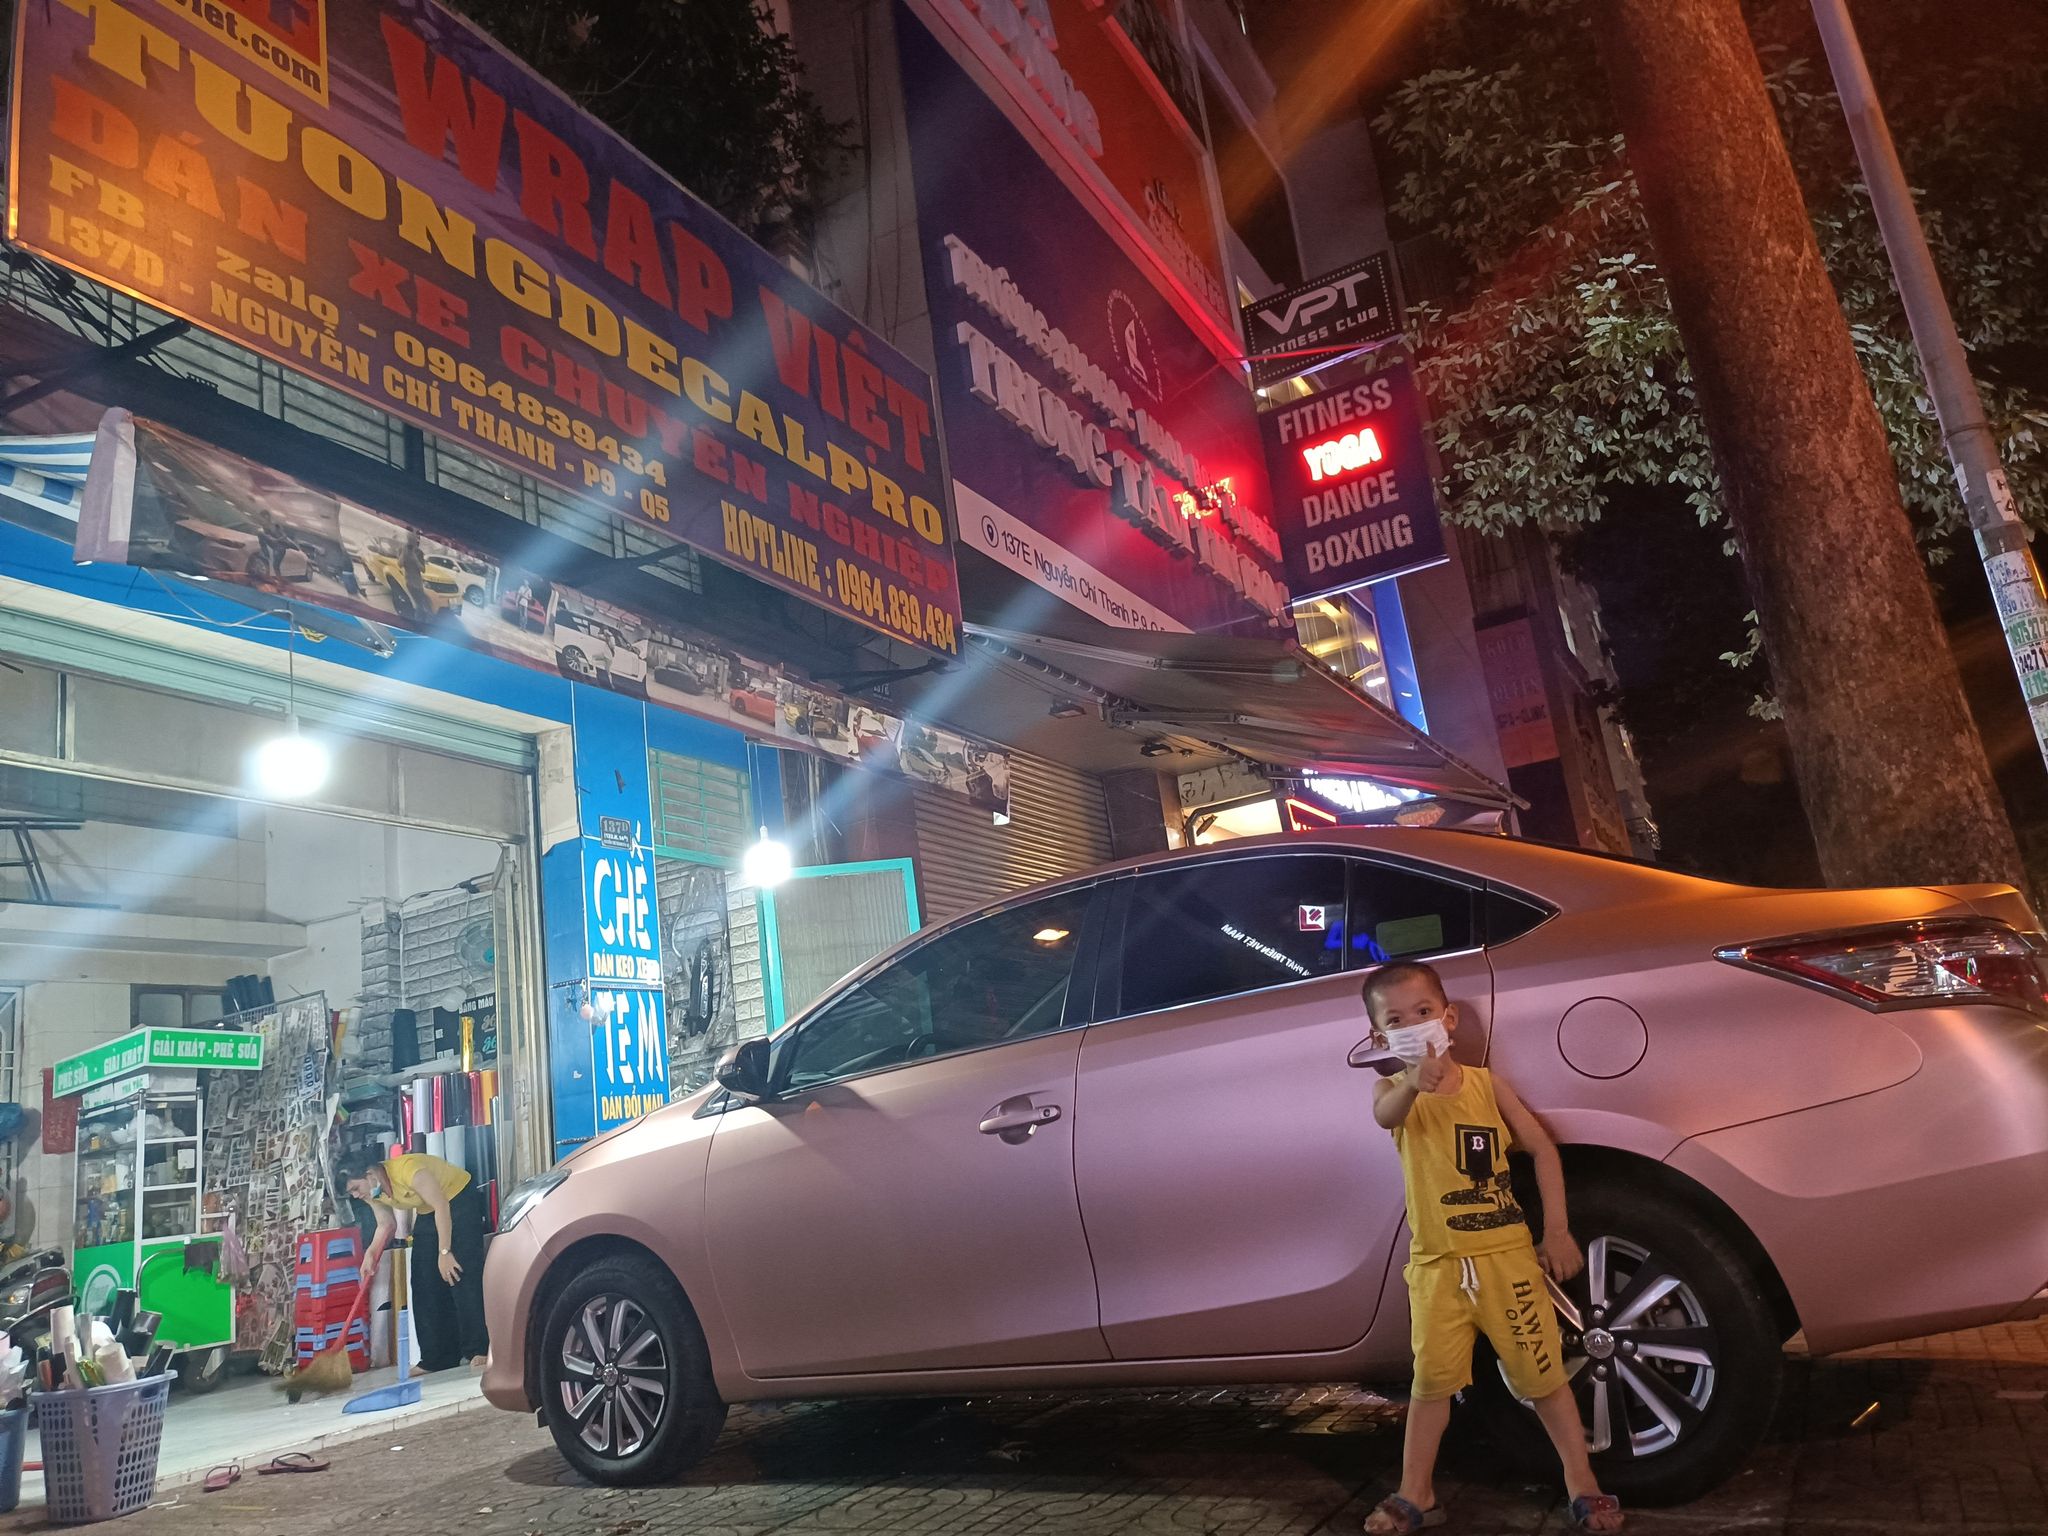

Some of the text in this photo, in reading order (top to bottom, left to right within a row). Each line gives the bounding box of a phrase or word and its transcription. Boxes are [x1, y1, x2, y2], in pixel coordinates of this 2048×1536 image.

[175, 0, 322, 95] iet.com
[57, 0, 944, 545] TUONGDECALPRO
[380, 12, 734, 335] WRAP
[759, 285, 932, 474] VIỆT
[51, 74, 950, 593] DÁN XE CHUYÊN NGHIỆP
[1256, 271, 1371, 335] VPT
[1260, 305, 1379, 364] FITNESS CLUB
[49, 203, 165, 288] 137D
[210, 280, 370, 385] NGUYỄN
[383, 365, 442, 418] CHÍ
[451, 396, 557, 471] THANH
[582, 458, 617, 498] P9
[640, 487, 670, 523] Q5
[394, 330, 667, 488] 0964839434
[956, 320, 1112, 487] TRUNG
[1277, 377, 1392, 445] FITNESS
[1302, 427, 1383, 481] YOGA
[1301, 469, 1399, 529] DANCE
[1304, 513, 1414, 575] BOXING
[720, 500, 821, 593] HOTLINE
[836, 557, 957, 655] 0964.839.434
[1001, 530, 1033, 566] 137E
[1034, 548, 1078, 592] Nguyễn
[1098, 588, 1130, 625] Thanh
[593, 949, 614, 977] DÁN
[615, 955, 635, 978] KEO
[177, 1038, 206, 1057] KHÁT
[596, 989, 665, 1084] TEM
[601, 1090, 622, 1121] DÁN
[624, 1085, 642, 1119] ĐỔI
[1512, 1279, 1552, 1376] HAWAII
